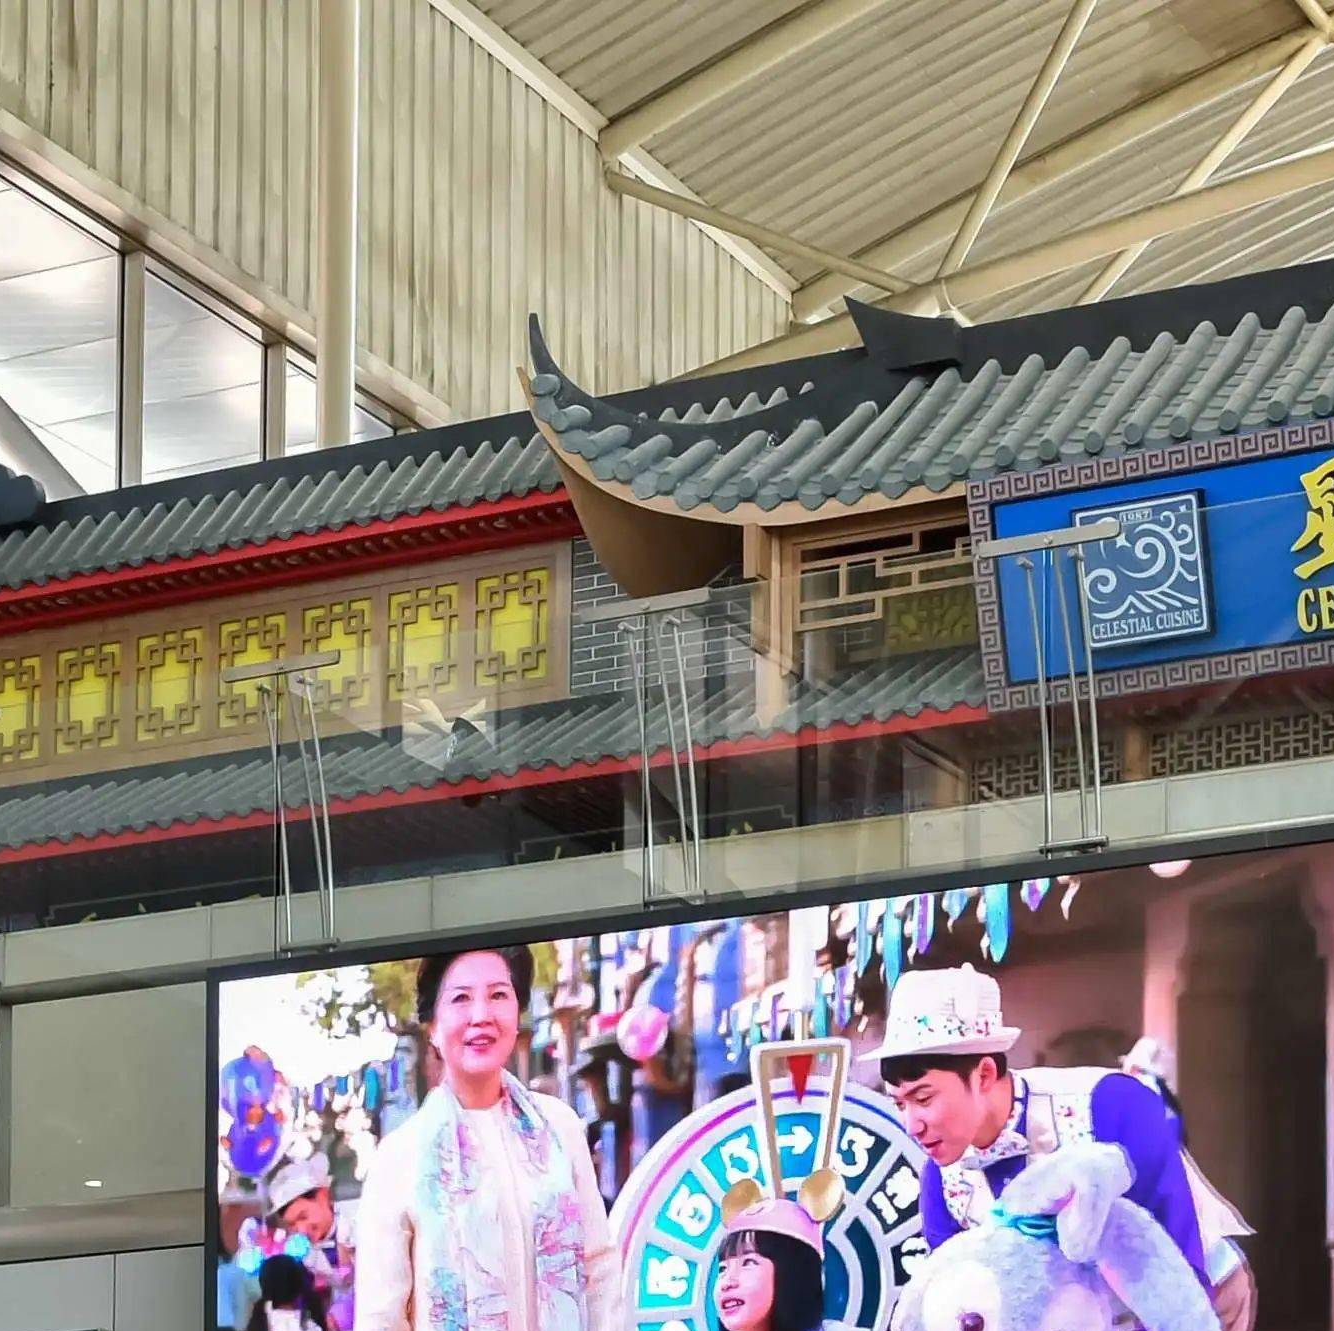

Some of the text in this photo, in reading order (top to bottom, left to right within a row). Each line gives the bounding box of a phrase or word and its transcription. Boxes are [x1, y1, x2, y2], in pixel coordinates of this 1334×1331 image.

[1121, 510, 1150, 522] 1987
[1092, 608, 1202, 640] CELESTIAL CUISINE
